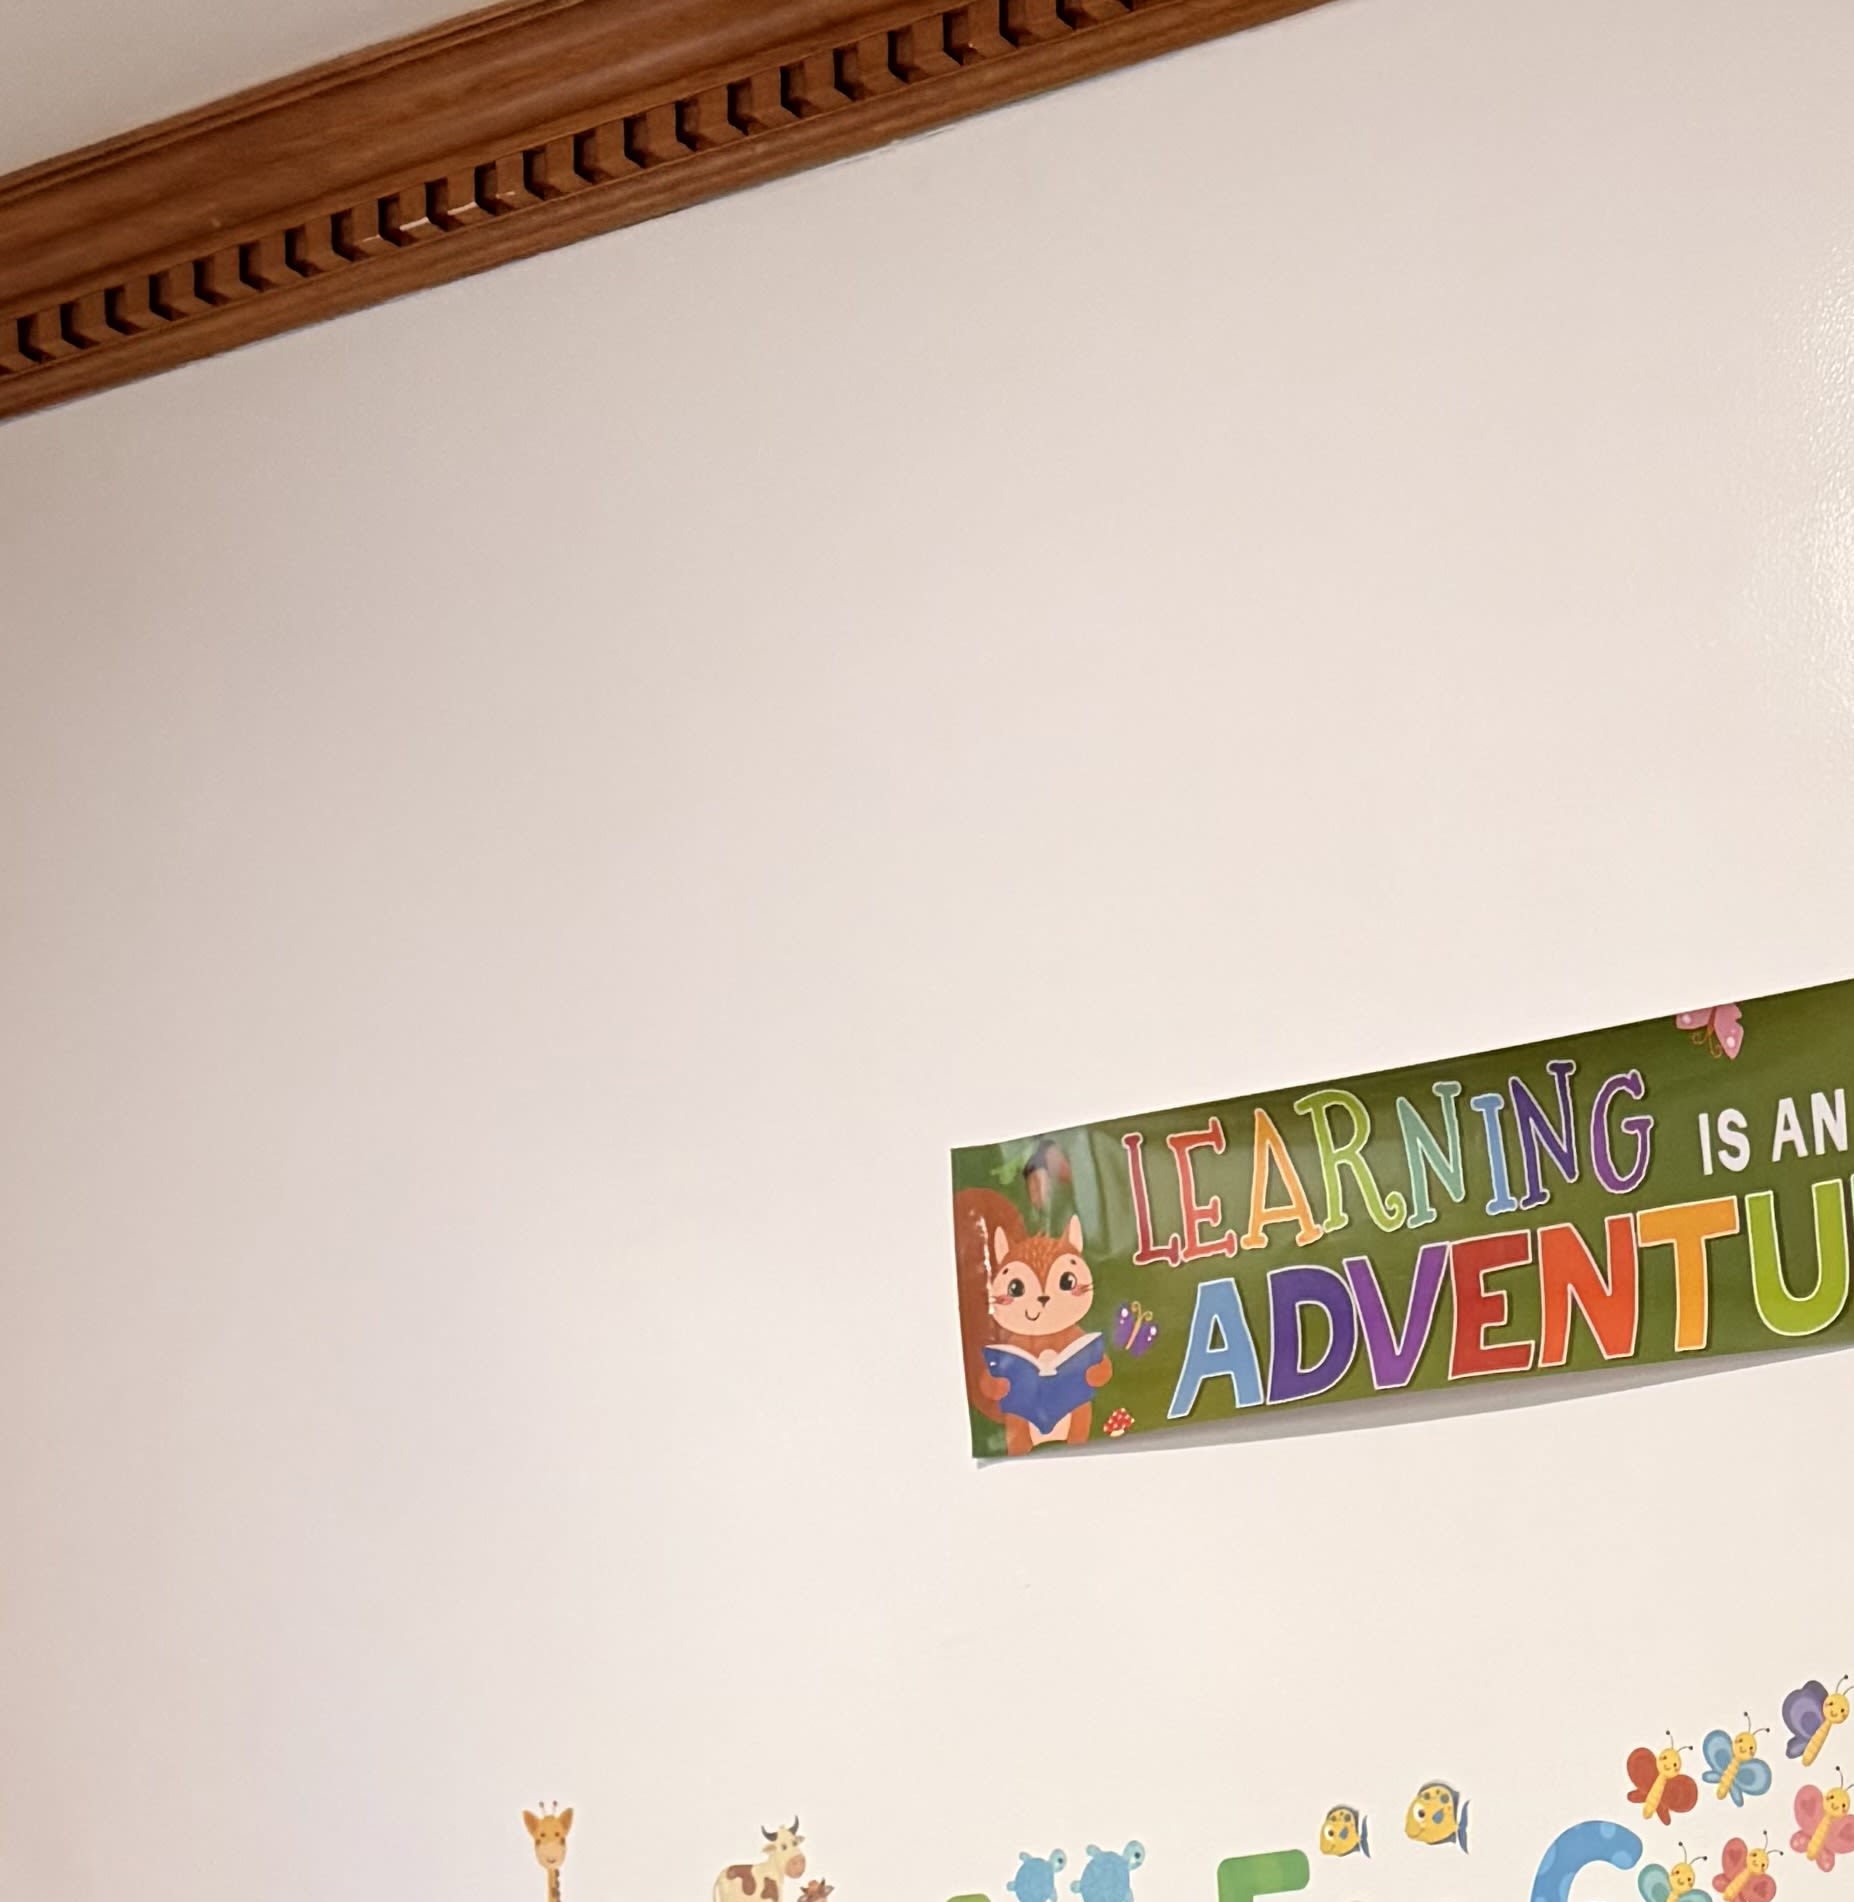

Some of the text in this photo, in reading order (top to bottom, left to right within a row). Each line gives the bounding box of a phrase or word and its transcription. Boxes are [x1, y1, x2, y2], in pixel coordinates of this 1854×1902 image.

[1119, 1058, 1848, 1269] LEARNING IS AN
